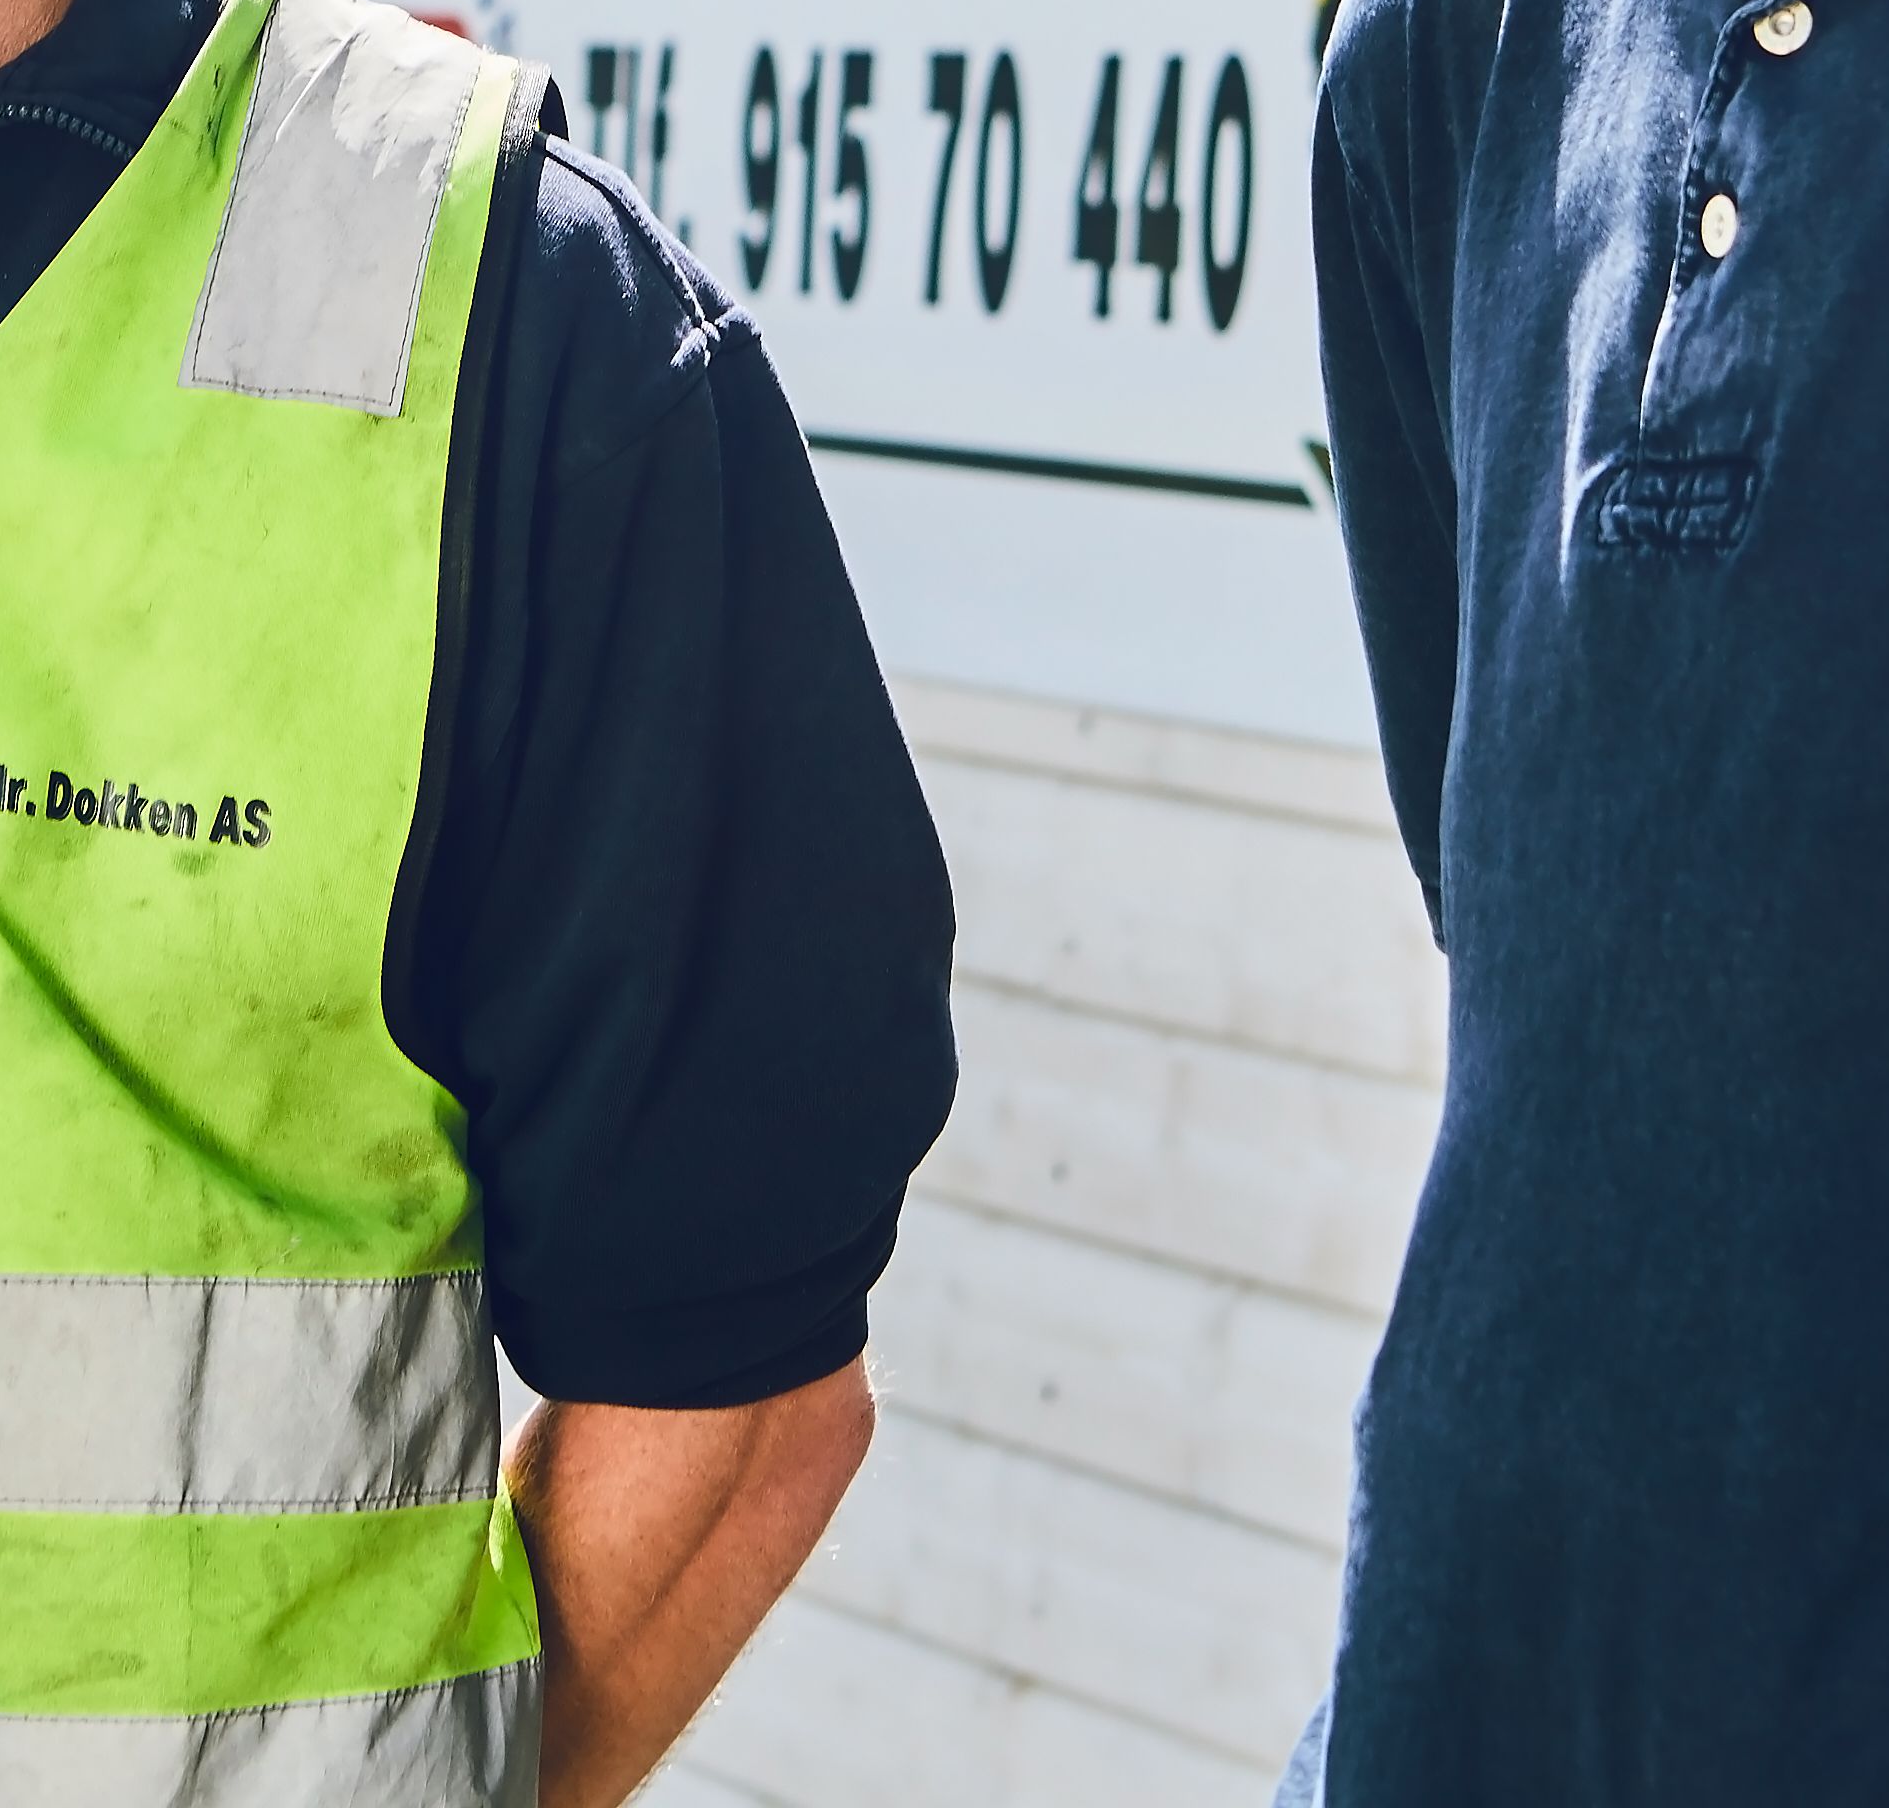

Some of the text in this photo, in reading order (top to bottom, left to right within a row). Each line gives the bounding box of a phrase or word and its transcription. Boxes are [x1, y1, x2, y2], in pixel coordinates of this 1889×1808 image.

[740, 44, 874, 302] 915
[924, 49, 1024, 316] 70
[1073, 52, 1254, 334] 440
[45, 769, 199, 842] Dokken
[208, 794, 273, 849] AS
